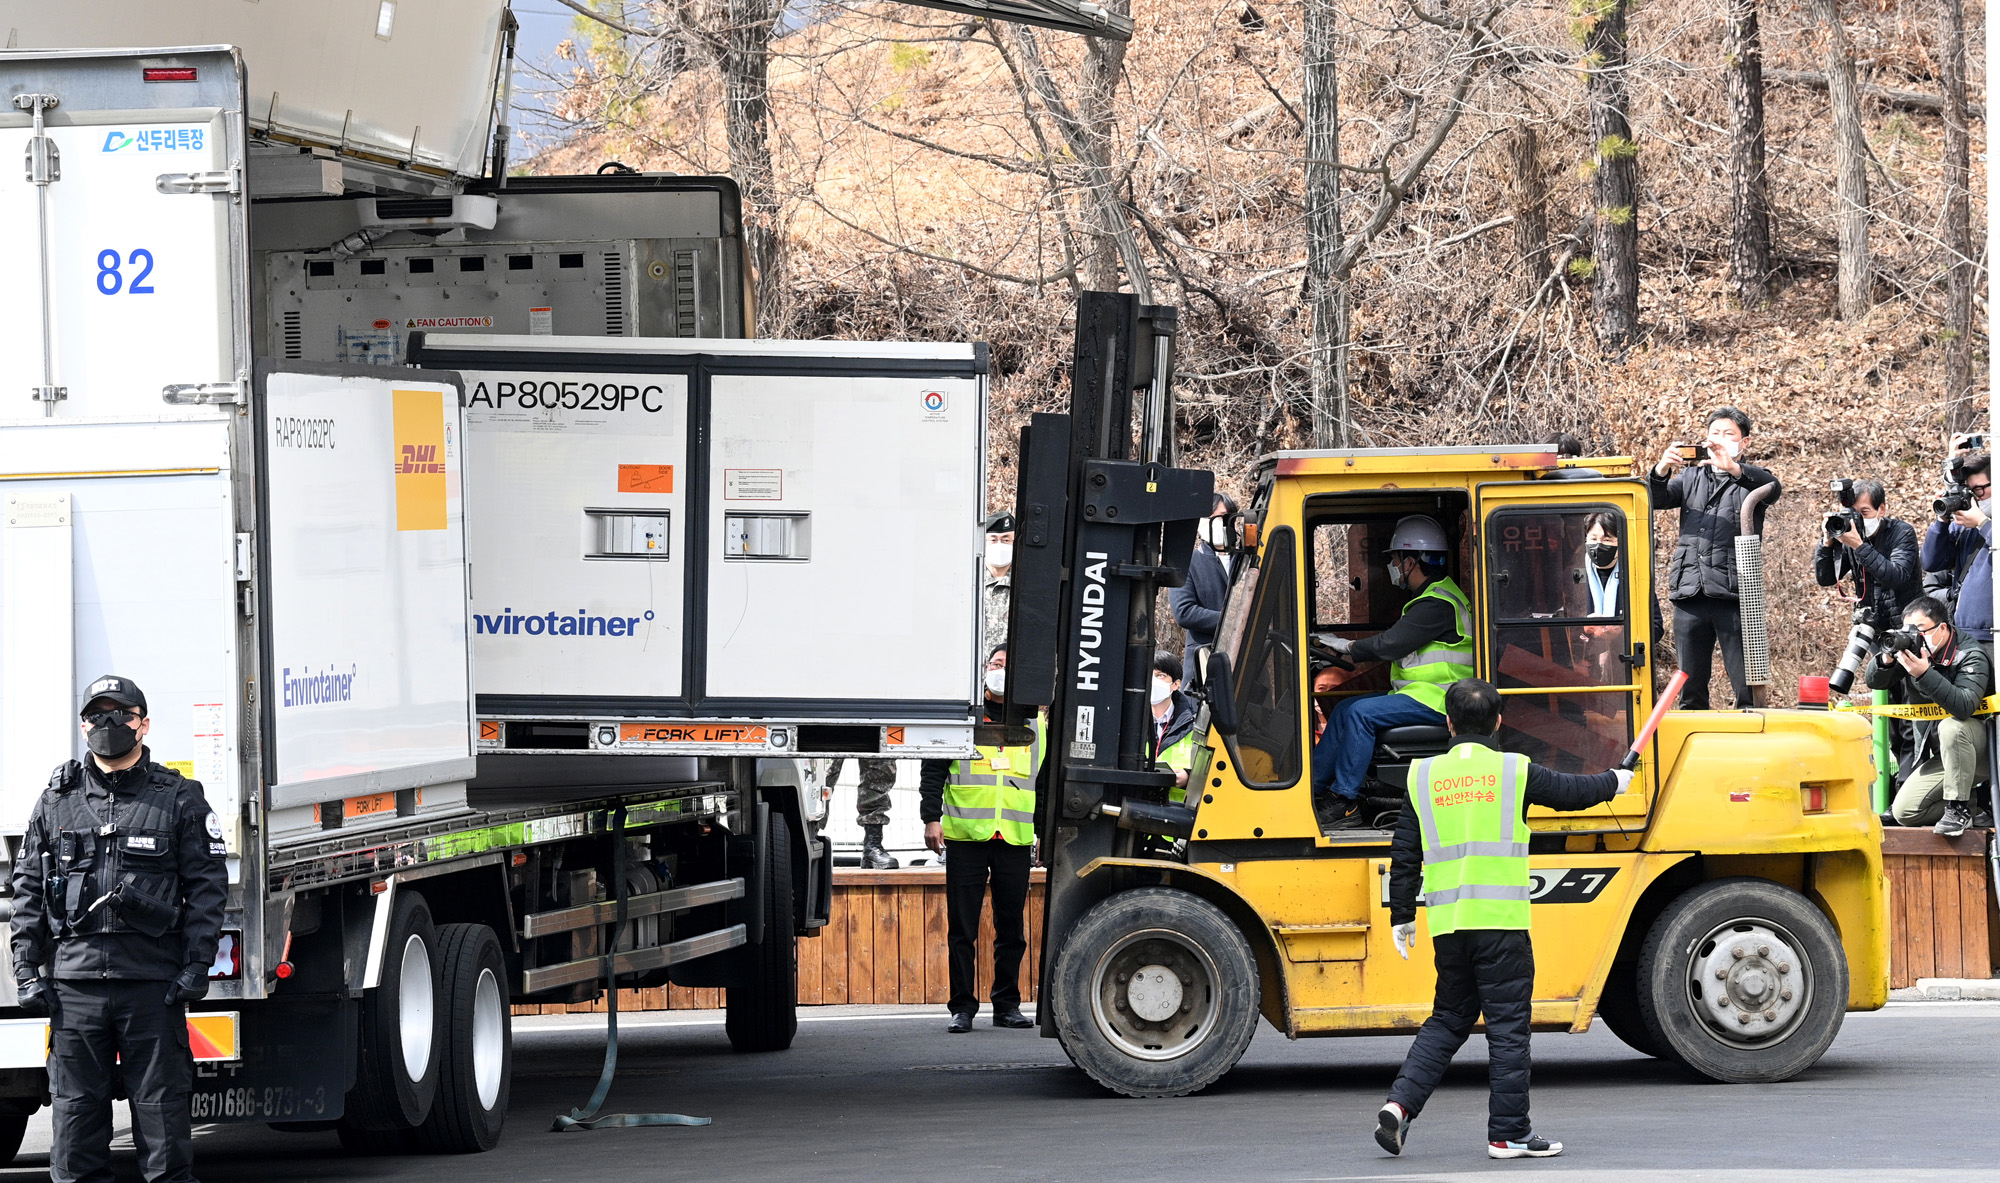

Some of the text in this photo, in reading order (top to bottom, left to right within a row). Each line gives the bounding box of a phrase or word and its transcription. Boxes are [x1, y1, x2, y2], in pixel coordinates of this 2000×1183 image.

[136, 128, 204, 151] 신두리특장
[97, 248, 154, 295] 82
[416, 317, 481, 327] FAN CAUTION
[468, 381, 663, 412] AP80529PC
[275, 417, 336, 449] RAP81262PC
[400, 445, 441, 473] DHL
[473, 607, 641, 637] nvirotainer
[1076, 551, 1108, 691] HYUNDAI
[644, 728, 744, 741] FORK LIFT
[1434, 774, 1496, 792] COVID-19
[356, 797, 384, 814] FORK LIFT
